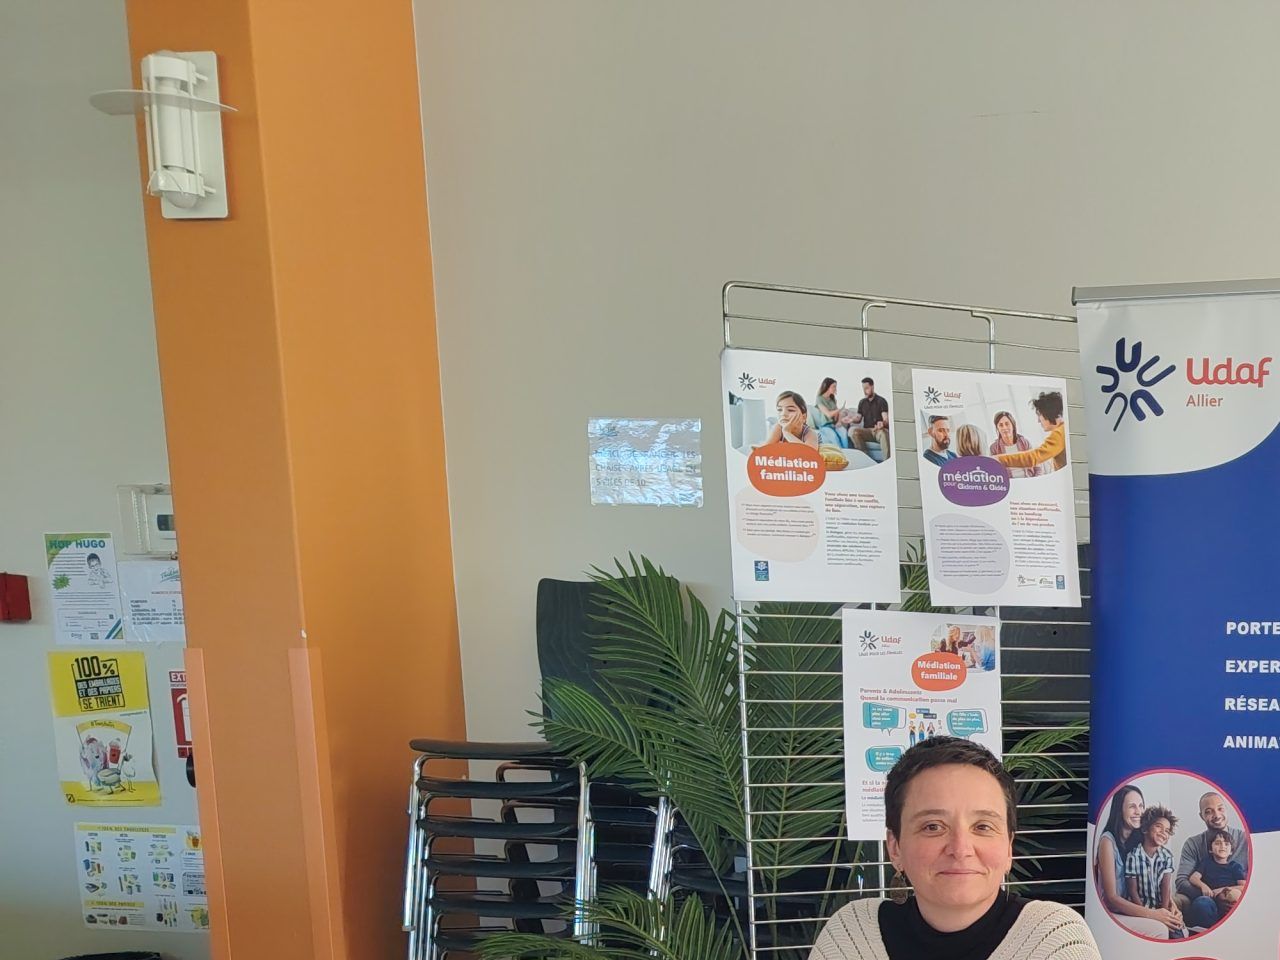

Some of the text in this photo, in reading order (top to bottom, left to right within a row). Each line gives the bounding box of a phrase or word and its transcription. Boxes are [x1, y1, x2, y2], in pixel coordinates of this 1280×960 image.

[1186, 356, 1272, 388] Udaf
[1186, 394, 1224, 408] Allier
[754, 455, 818, 469] Médiation
[760, 468, 815, 482] familiale
[943, 469, 1004, 483] médiation
[75, 539, 106, 549] HUGO
[917, 660, 961, 670] Médiation
[170, 672, 187, 682] EXT
[920, 671, 958, 680] familiale
[82, 694, 121, 709] SE TRIENT
